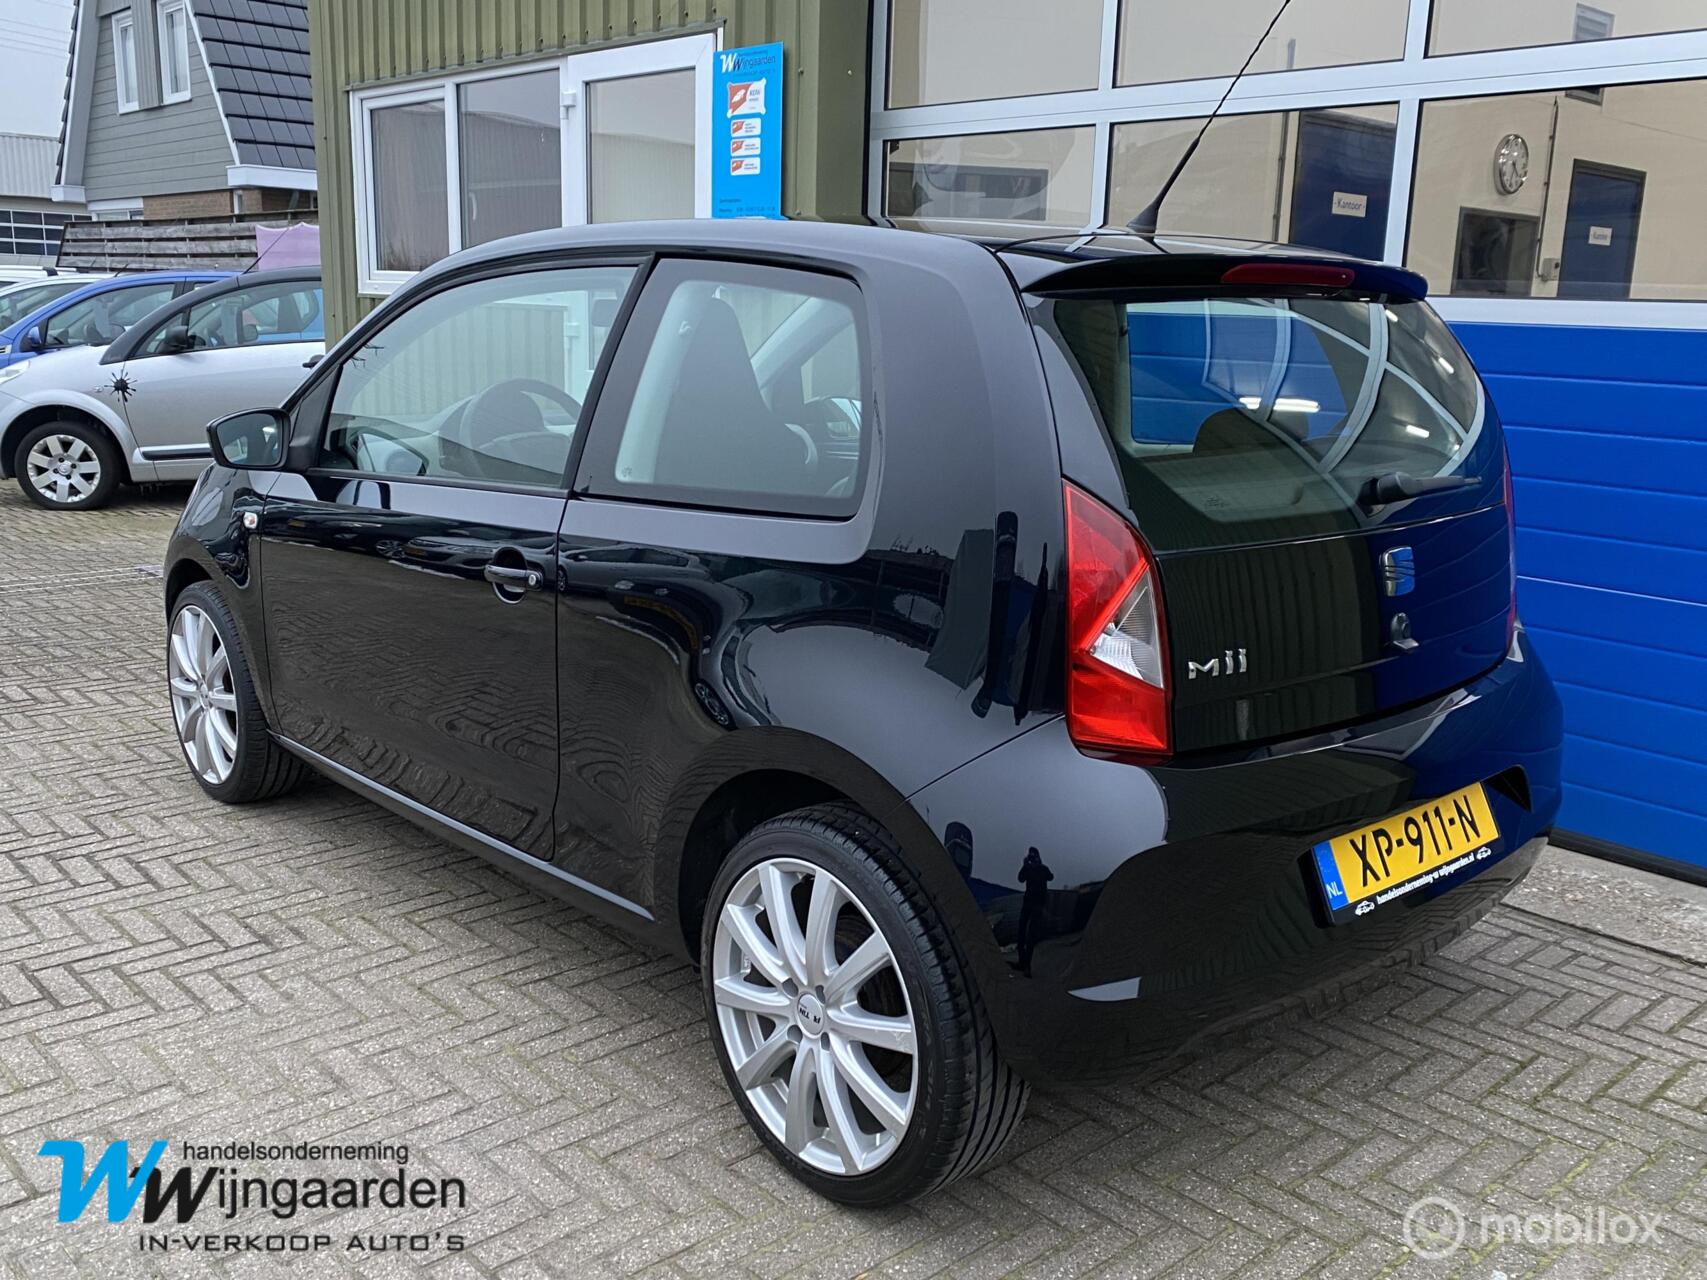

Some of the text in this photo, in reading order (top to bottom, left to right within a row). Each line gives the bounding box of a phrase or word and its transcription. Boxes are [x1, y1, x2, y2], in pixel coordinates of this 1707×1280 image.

[1188, 648, 1247, 679] Mii
[1349, 795, 1481, 887] XP-911-N
[1326, 883, 1343, 899] NL
